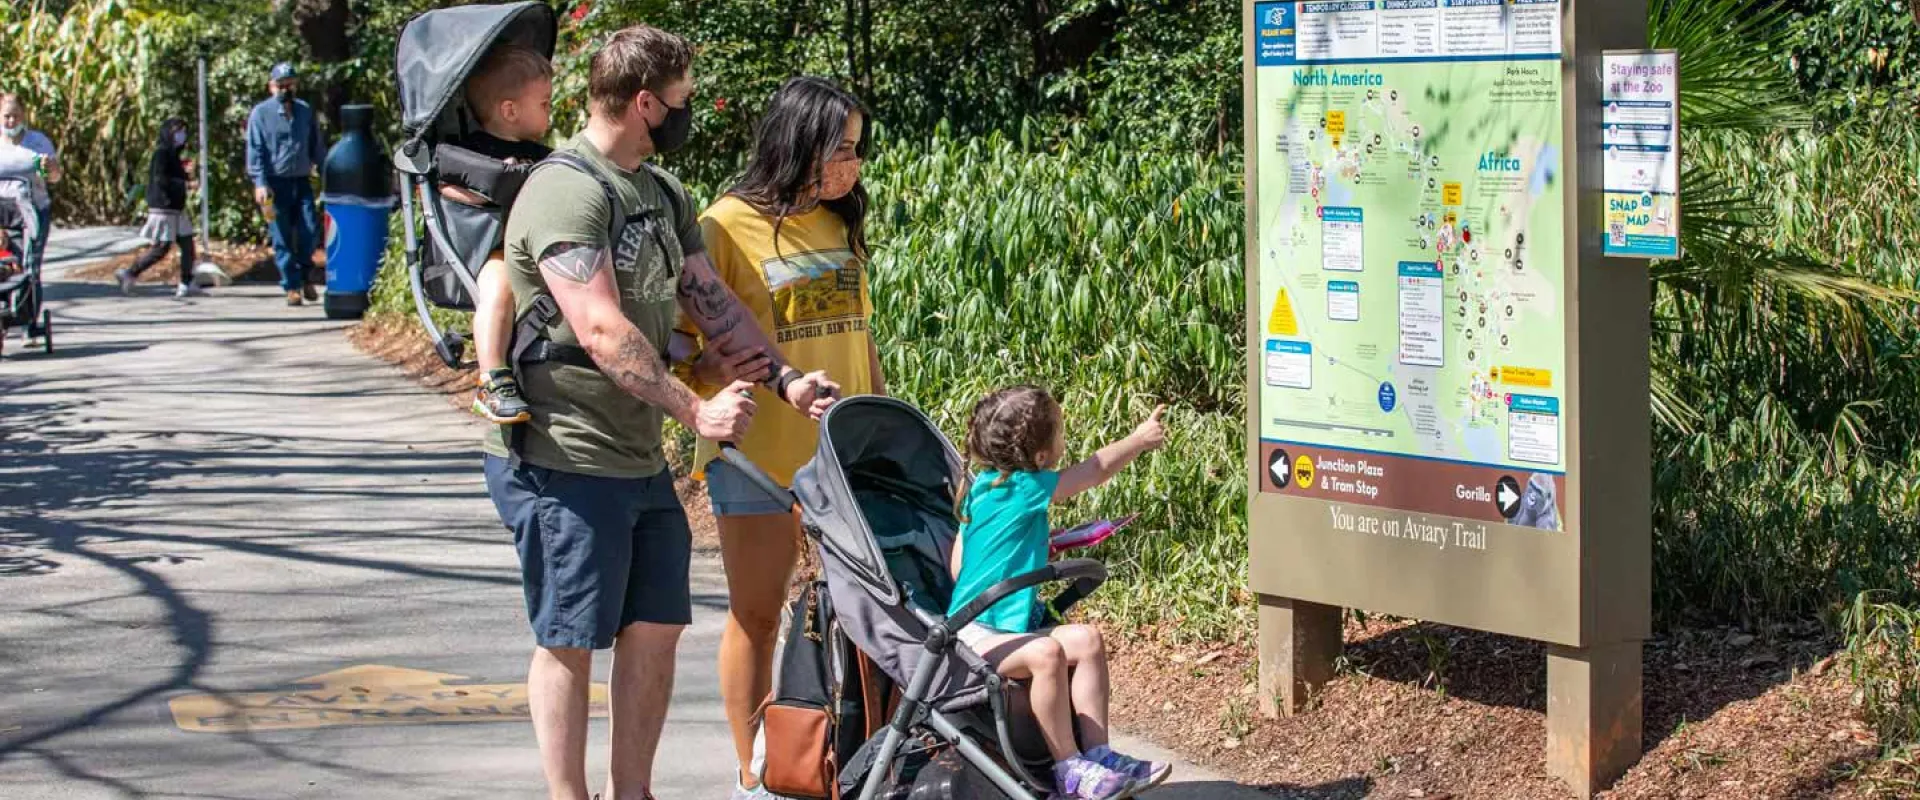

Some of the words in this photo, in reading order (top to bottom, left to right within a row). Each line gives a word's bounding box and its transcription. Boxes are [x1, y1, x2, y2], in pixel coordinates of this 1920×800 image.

[1306, 4, 1340, 13] TEMPORARY
[1340, 2, 1369, 11] CLOSURES
[1387, 1, 1410, 9] DINING
[1410, 0, 1435, 8] OPTIONS
[1293, 68, 1328, 86] North
[1331, 68, 1383, 86] America
[1506, 67, 1520, 75] Park
[1521, 67, 1538, 75] Hours
[1610, 63, 1648, 77] Staying
[1650, 64, 1672, 75] safe
[1610, 82, 1620, 93] at
[1623, 80, 1640, 92] the
[1643, 81, 1664, 93] Zoo
[1478, 151, 1520, 171] Africa
[1610, 199, 1638, 211] SNAP
[1626, 214, 1650, 226] MAP
[1315, 455, 1356, 473] Junction
[1357, 460, 1384, 477] Plaza
[1320, 475, 1329, 490] &
[1330, 476, 1355, 494] Tram
[1355, 480, 1378, 500] Stop
[1455, 484, 1491, 502] Gorilla
[1329, 504, 1354, 531] You
[1357, 516, 1379, 534] are
[1382, 519, 1400, 538] on
[1402, 516, 1449, 550] Aviary
[1452, 522, 1487, 550] Trail
[267, 688, 512, 707] AVIARY
